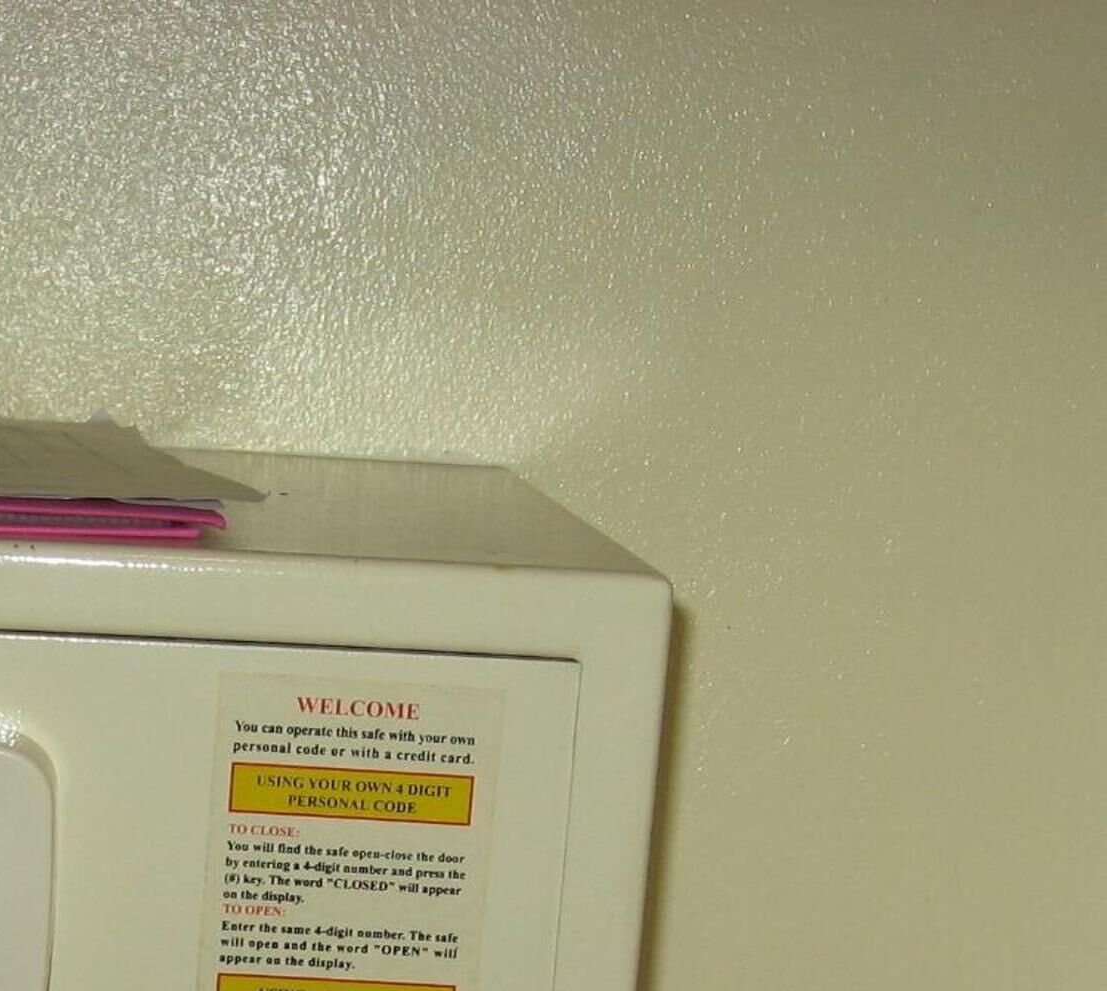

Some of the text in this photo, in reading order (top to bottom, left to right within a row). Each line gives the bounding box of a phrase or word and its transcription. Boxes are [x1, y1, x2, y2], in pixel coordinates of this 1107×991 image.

[296, 696, 419, 720] WELCOME
[235, 719, 475, 746] You can operate this safe with your own
[232, 741, 474, 764] personal code or with a credit card.
[256, 774, 452, 797] USING YOUR OWN 4 DIGIT
[288, 794, 417, 813] PERSONAL CODE
[229, 823, 247, 835] TO
[226, 839, 465, 863] You will find the safe open-close the door
[224, 855, 466, 880] by entering a 4-digit number and press the
[243, 873, 265, 886] key.
[268, 874, 290, 886] The
[293, 877, 323, 888] word
[398, 882, 419, 893] will
[421, 885, 462, 897] appear
[222, 889, 304, 905] on the display.
[222, 903, 241, 913] TO
[221, 919, 458, 943] Enter the same 4-digit number. The safe
[220, 936, 244, 947] will
[247, 939, 279, 951] open
[283, 940, 307, 950] and
[311, 940, 331, 952] the
[336, 943, 368, 954] word
[433, 946, 458, 959] will
[218, 954, 355, 971] appear on the display.
